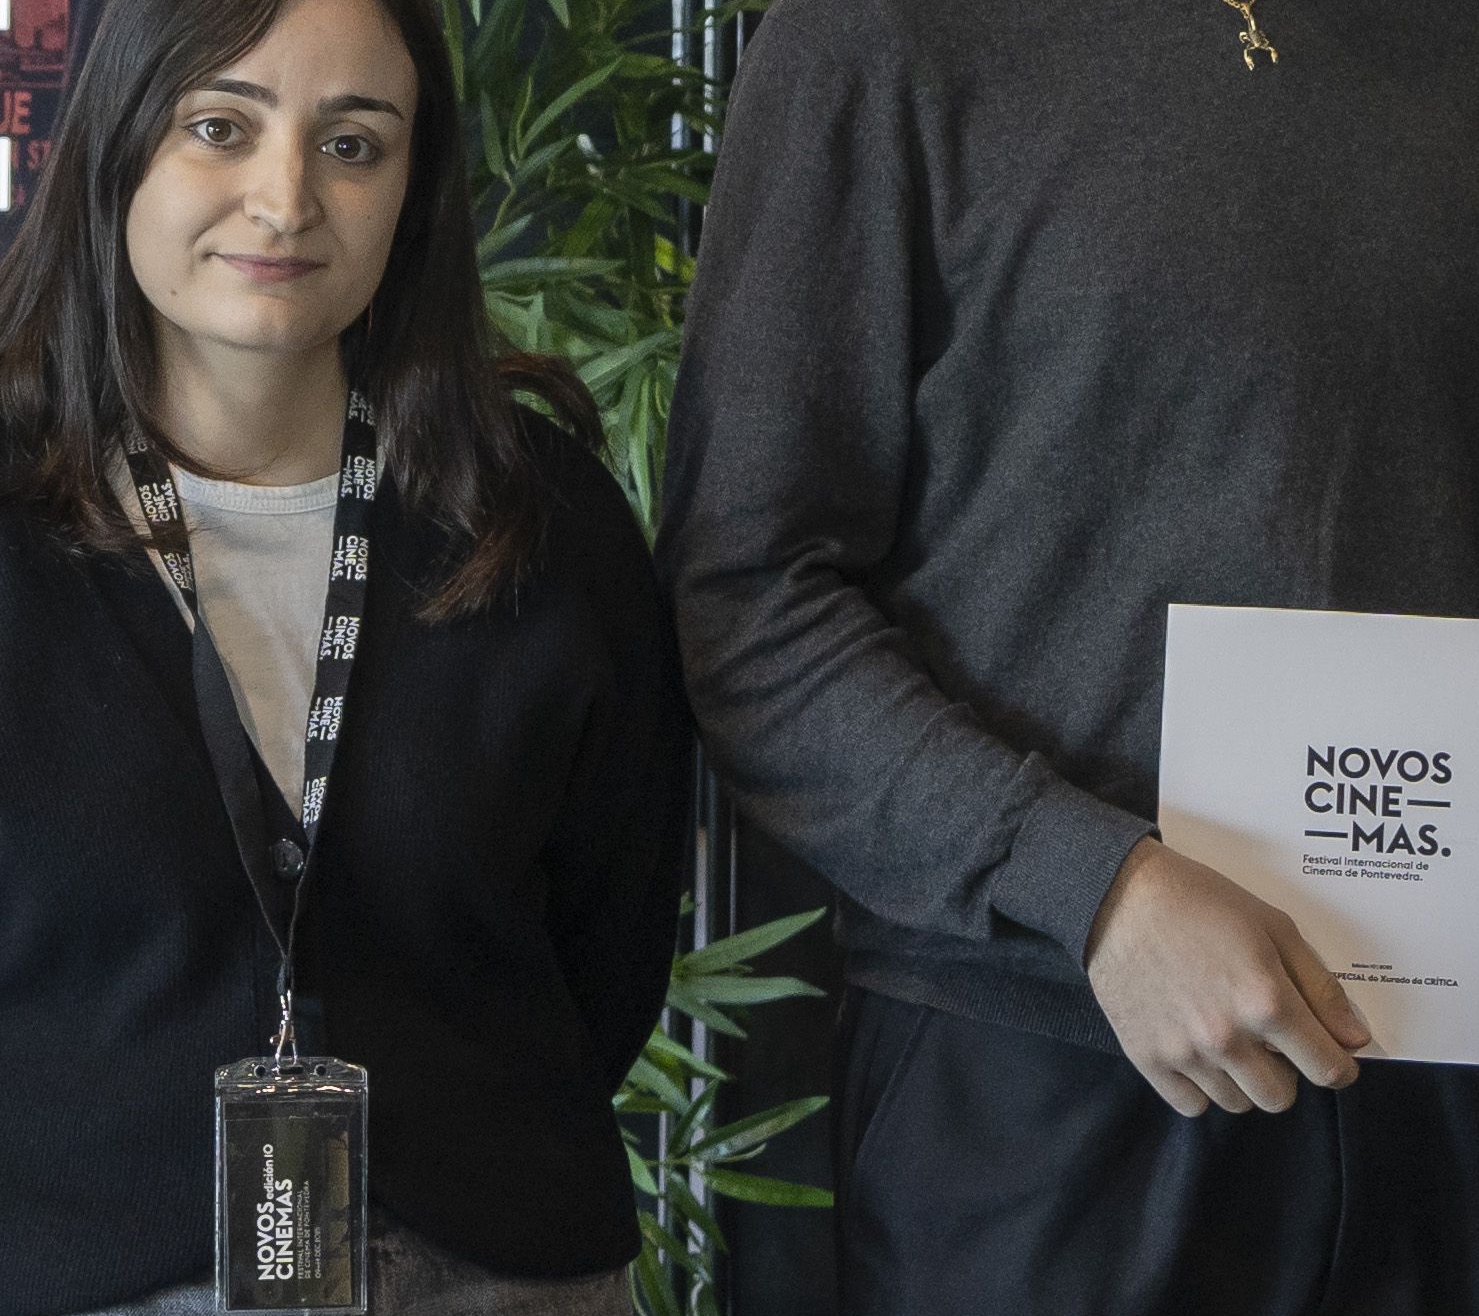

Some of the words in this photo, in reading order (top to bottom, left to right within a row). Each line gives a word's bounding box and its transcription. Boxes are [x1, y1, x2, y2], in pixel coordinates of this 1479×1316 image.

[363, 457, 376, 502] NOVOS
[138, 484, 161, 523] NOVOS
[354, 536, 369, 581] NOVOS
[341, 616, 361, 660] NOVOS
[326, 695, 344, 741] NOVOS
[1306, 744, 1453, 784] NOVOS
[1302, 854, 1342, 865] Festival
[1344, 856, 1413, 869] Internacional
[1415, 861, 1430, 871] de
[1302, 865, 1343, 876] Cinema
[1344, 868, 1358, 877] de
[1360, 870, 1423, 881] Pontevedra.
[262, 1159, 275, 1200] edición
[256, 1202, 276, 1281] NOVOS
[274, 1178, 294, 1281] CINEMAS
